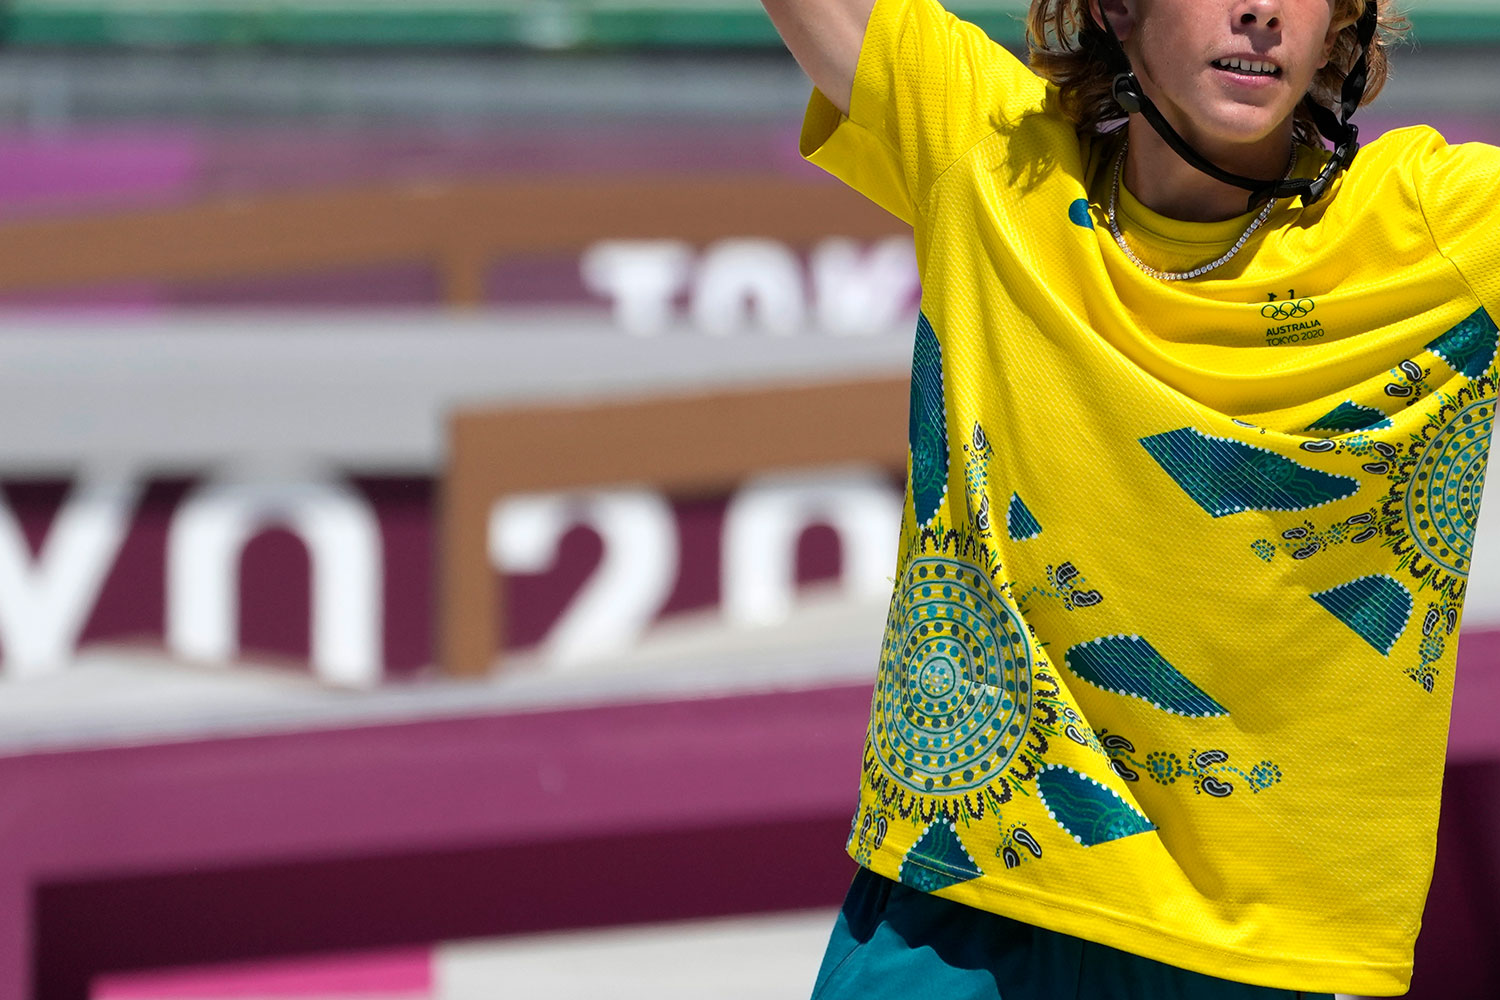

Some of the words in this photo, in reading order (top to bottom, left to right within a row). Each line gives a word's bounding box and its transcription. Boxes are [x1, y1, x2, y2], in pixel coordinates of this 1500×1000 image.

[1266, 319, 1321, 337] AUSTRALIA
[1266, 334, 1300, 347] TOKYO
[1301, 328, 1325, 341] 2020
